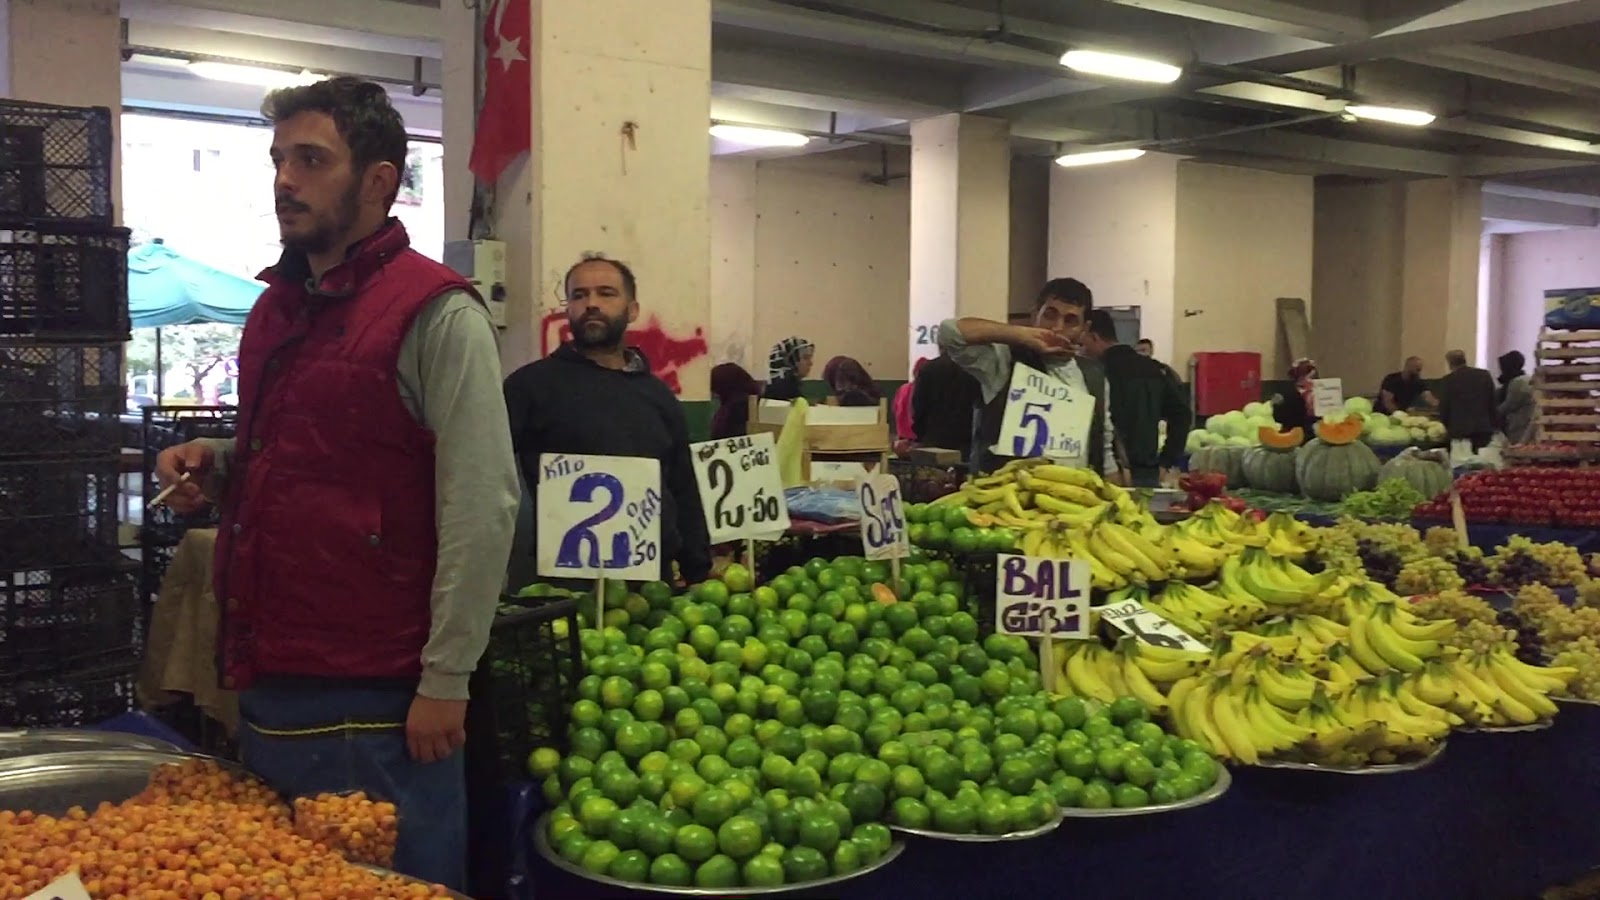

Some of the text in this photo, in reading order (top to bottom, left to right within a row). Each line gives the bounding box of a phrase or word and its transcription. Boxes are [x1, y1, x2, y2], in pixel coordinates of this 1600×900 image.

[1013, 402, 1052, 457] 5
[554, 472, 631, 569] 2
[633, 540, 657, 566] 50
[1002, 556, 1082, 600] BAL
